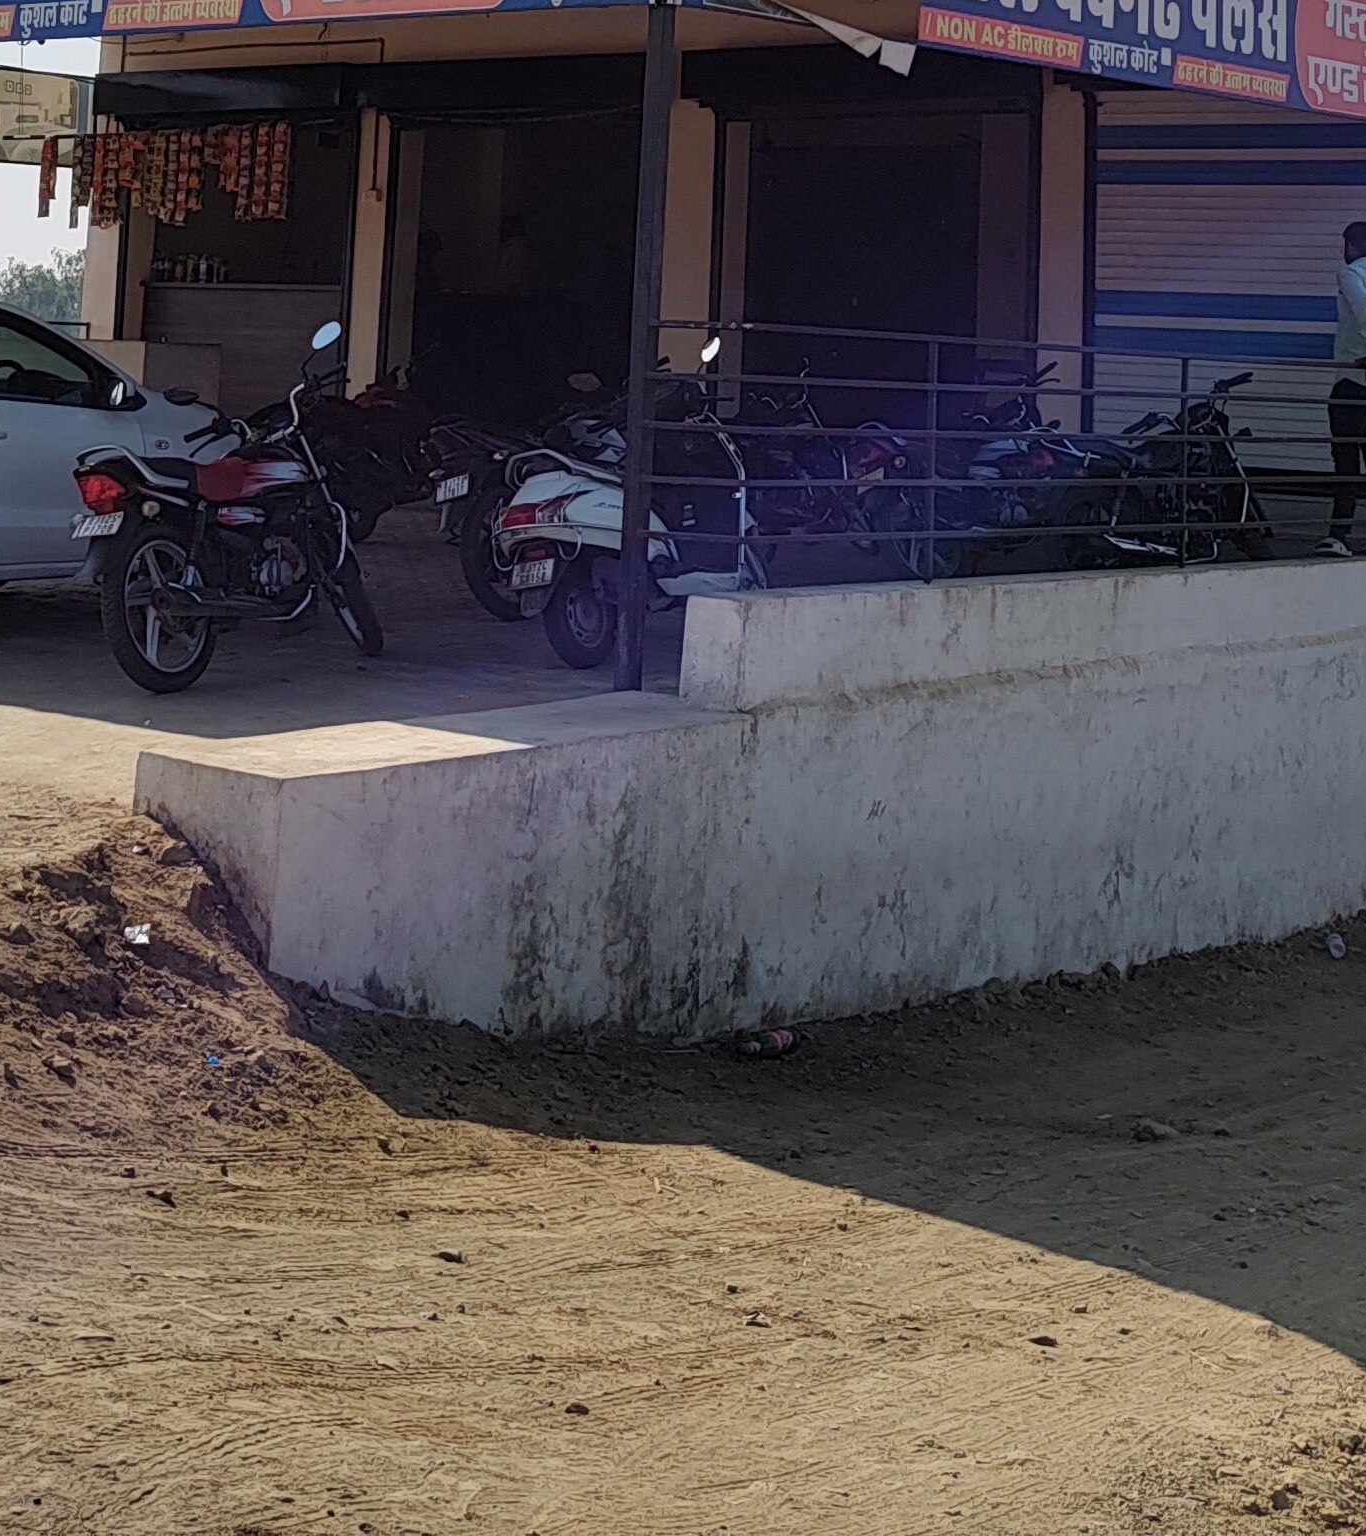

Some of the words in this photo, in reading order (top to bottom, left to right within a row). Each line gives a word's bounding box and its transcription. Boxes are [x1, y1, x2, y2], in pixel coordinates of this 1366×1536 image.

[19, 2, 59, 38] कुशल
[936, 14, 976, 43] NON
[981, 24, 1006, 48] AC
[1088, 38, 1129, 74] कुशल
[1129, 40, 1158, 74] कोट
[1209, 64, 1224, 88] की
[1307, 55, 1360, 105] एण्ड
